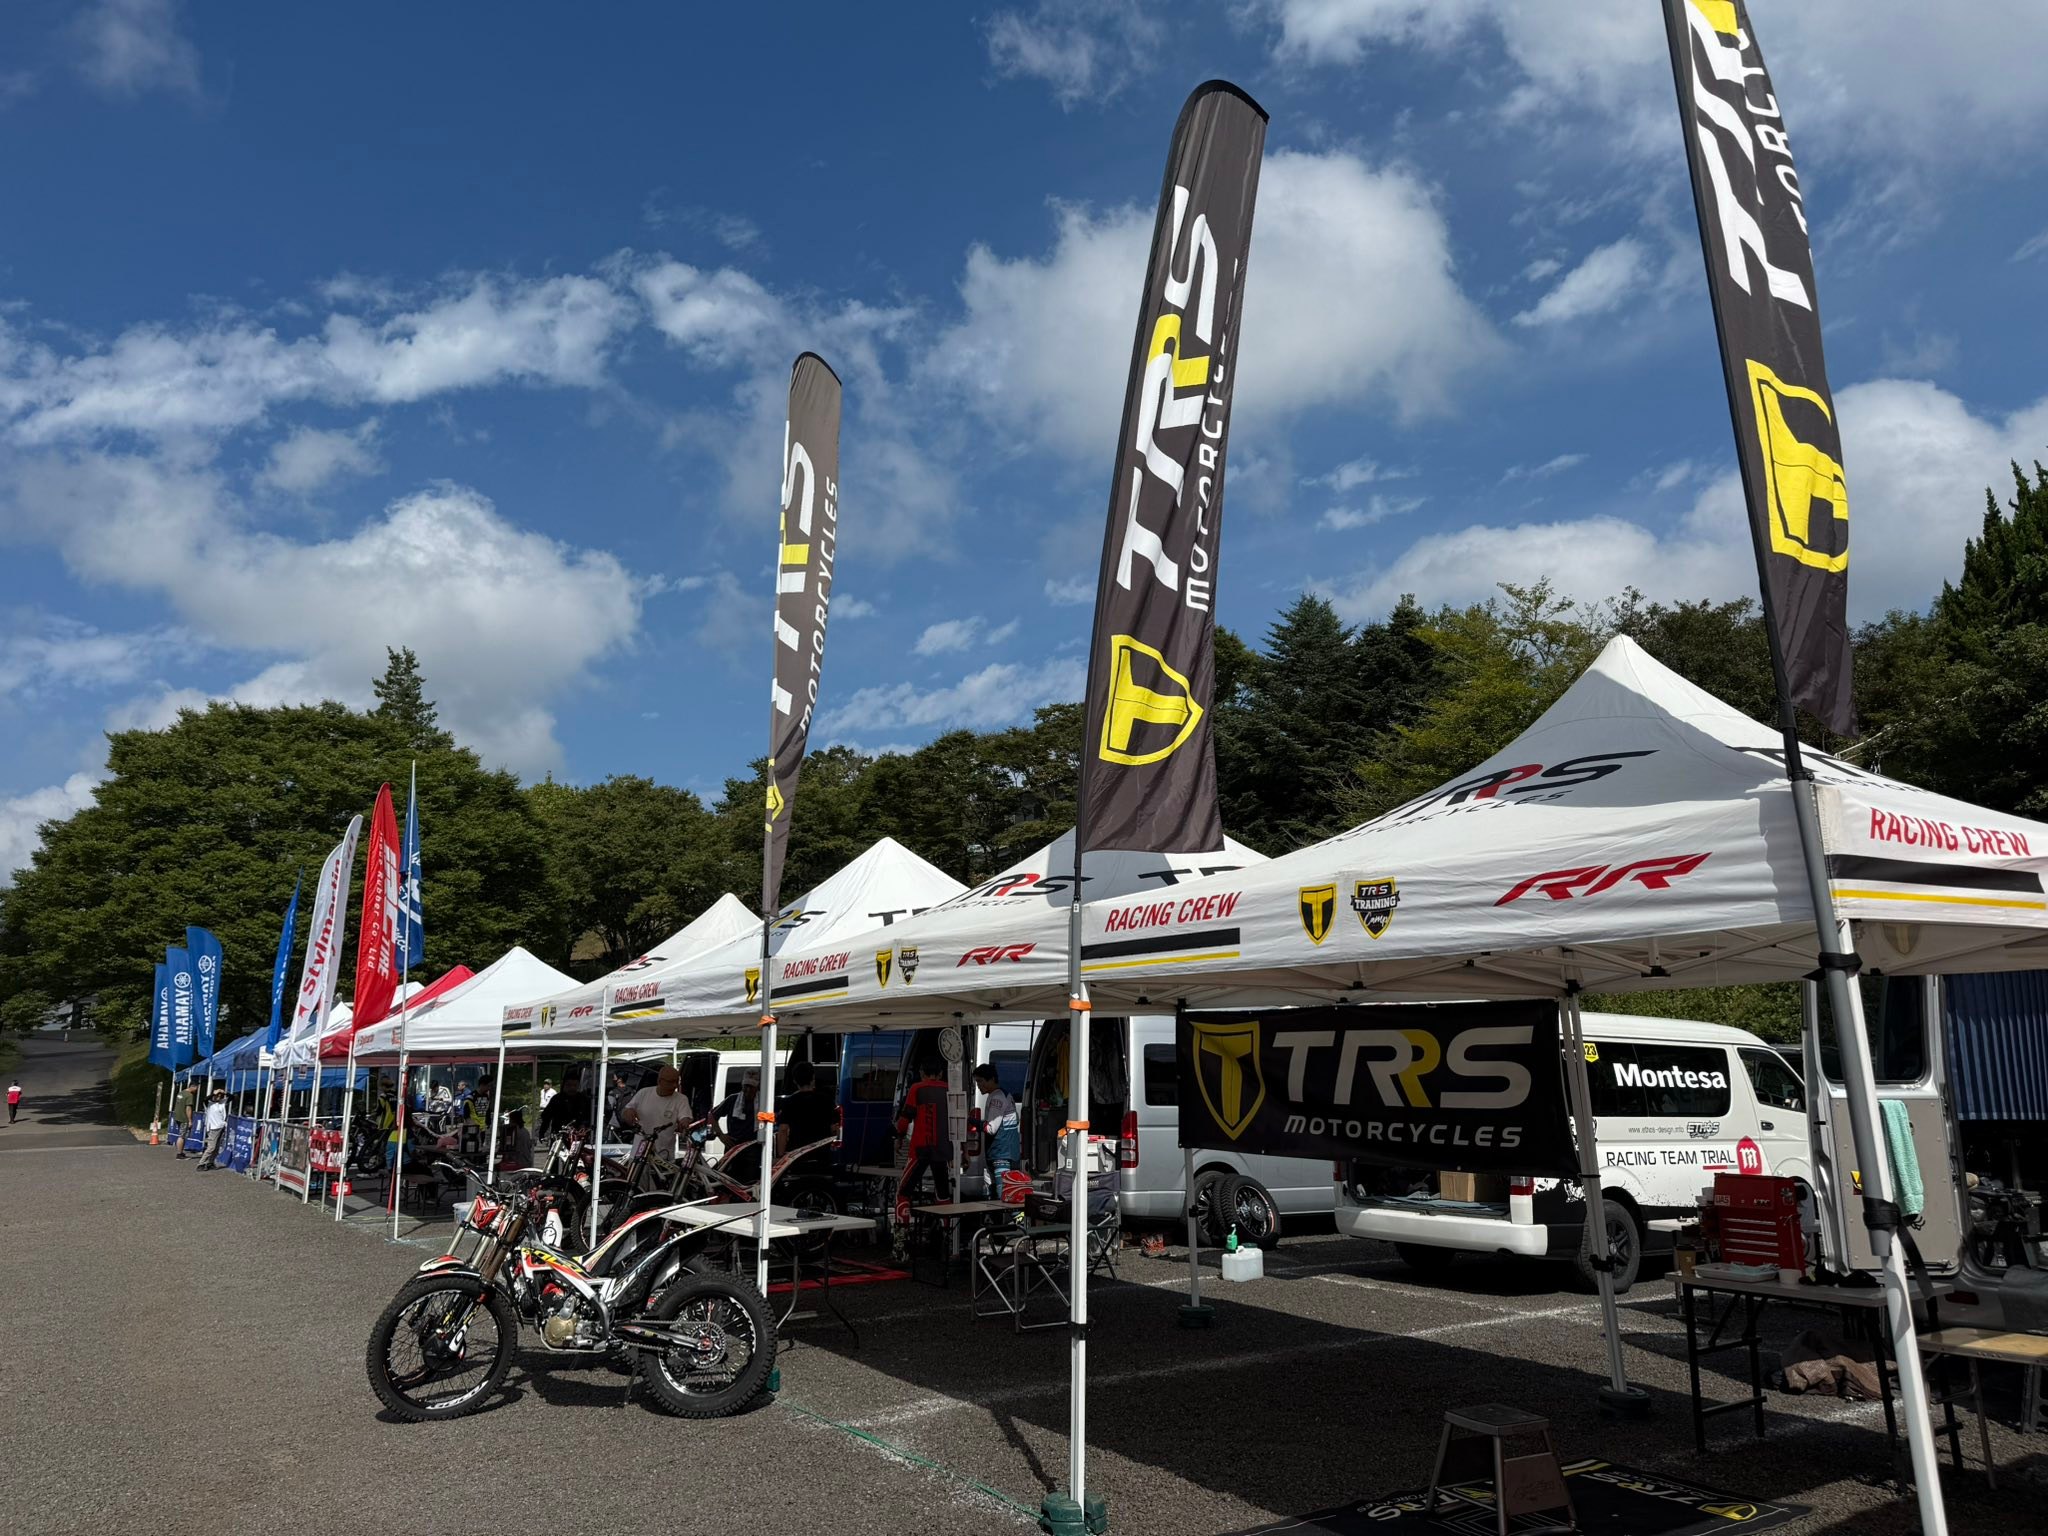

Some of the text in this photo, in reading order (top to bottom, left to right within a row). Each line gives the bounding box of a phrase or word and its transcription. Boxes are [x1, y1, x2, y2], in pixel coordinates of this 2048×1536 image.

[1869, 806, 2033, 857] RACING CREW
[373, 870, 384, 917] Rubber
[1354, 895, 1397, 910] TRAINING
[1104, 890, 1244, 934] RACING CREW
[377, 930, 392, 980] TIRE
[782, 950, 851, 980] RACING CREW
[614, 980, 662, 1005] RACING CREW
[1612, 1062, 1728, 1089] Montesa
[1283, 1114, 1523, 1148] MOTORCYCLES
[1606, 1149, 1736, 1167] RACING TEAM TRIAL
